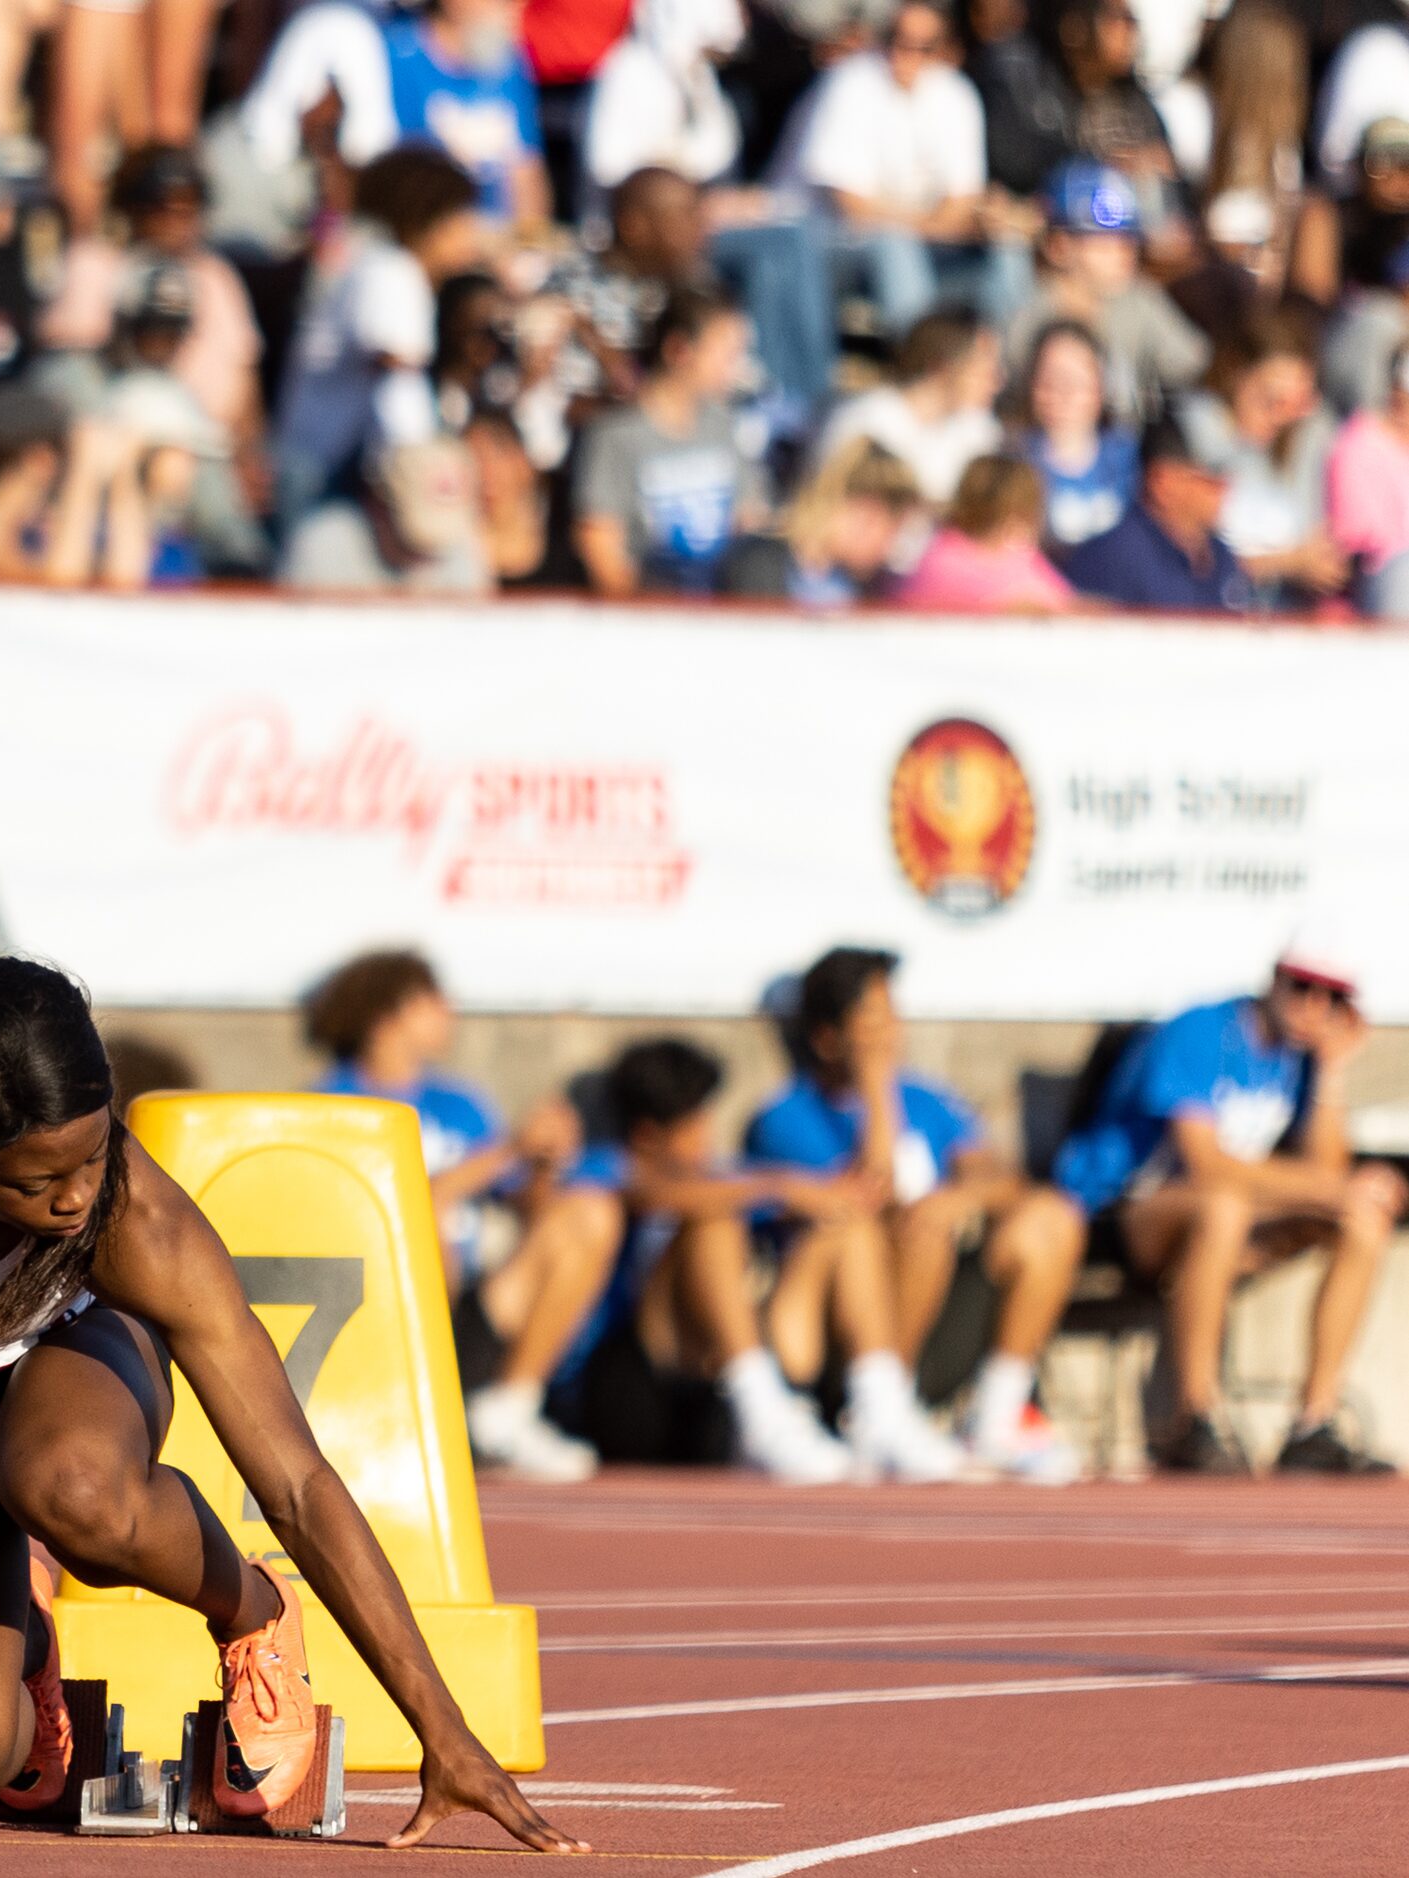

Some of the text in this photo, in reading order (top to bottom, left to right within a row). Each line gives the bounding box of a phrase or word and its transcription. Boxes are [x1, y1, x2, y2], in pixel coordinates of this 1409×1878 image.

[166, 698, 447, 870] Bally
[469, 764, 666, 842] SPORTS
[1066, 772, 1152, 830] High
[228, 1254, 366, 1522] 7
